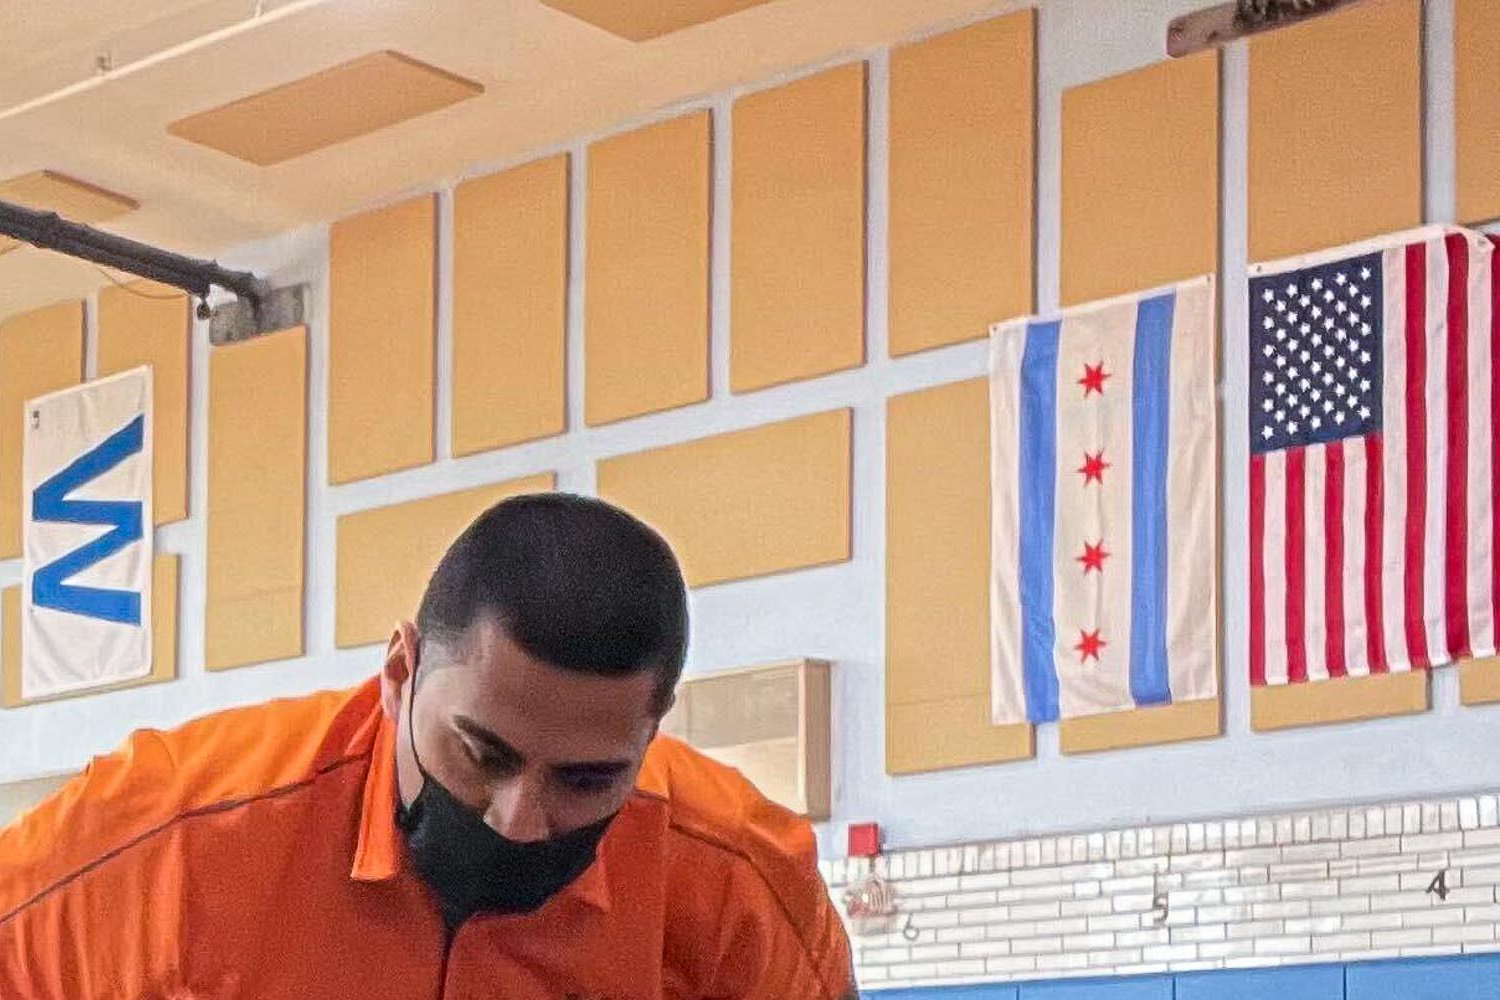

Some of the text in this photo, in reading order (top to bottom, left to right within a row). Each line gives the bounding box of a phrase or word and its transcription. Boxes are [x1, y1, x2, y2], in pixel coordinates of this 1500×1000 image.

[32, 414, 145, 627] W
[1426, 869, 1450, 901] 4
[903, 912, 920, 941] 6
